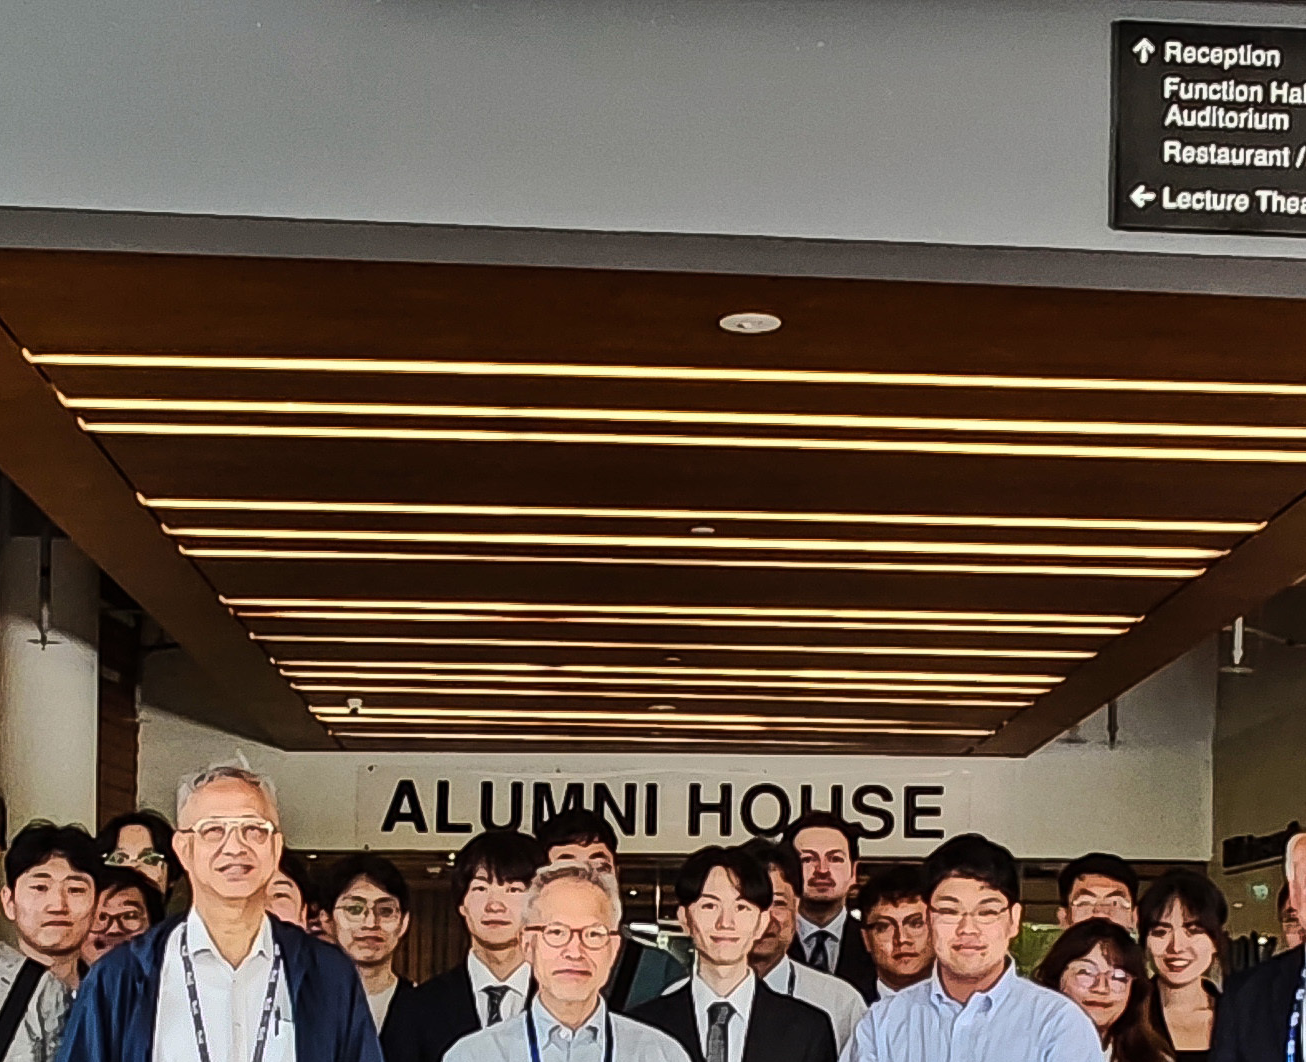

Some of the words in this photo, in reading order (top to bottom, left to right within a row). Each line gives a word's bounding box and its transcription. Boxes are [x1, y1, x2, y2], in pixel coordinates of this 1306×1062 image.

[1163, 41, 1281, 70] Reception
[1163, 77, 1264, 103] Function
[1164, 104, 1290, 130] Auditorium
[1163, 141, 1291, 168] Restaurant
[1295, 146, 1306, 168] /
[1162, 186, 1250, 212] Lecture
[380, 779, 658, 837] ALUMNI
[687, 783, 945, 840] HOUSE
